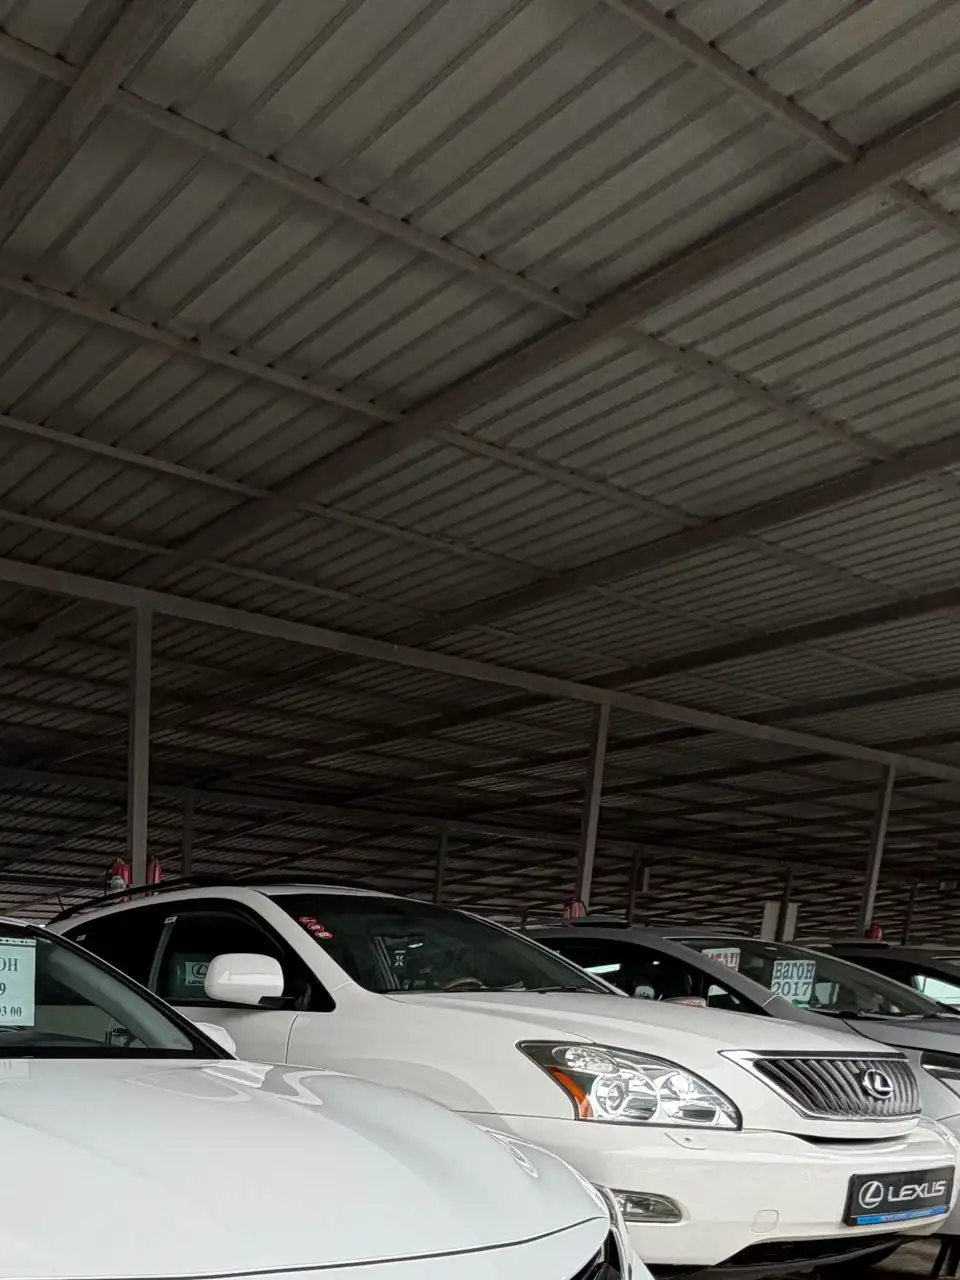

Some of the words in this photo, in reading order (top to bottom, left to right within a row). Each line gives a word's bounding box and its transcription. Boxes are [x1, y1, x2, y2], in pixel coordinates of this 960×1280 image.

[772, 981, 813, 997] 2017
[10, 1006, 22, 1017] 00
[887, 1180, 946, 1202] LEXUS
